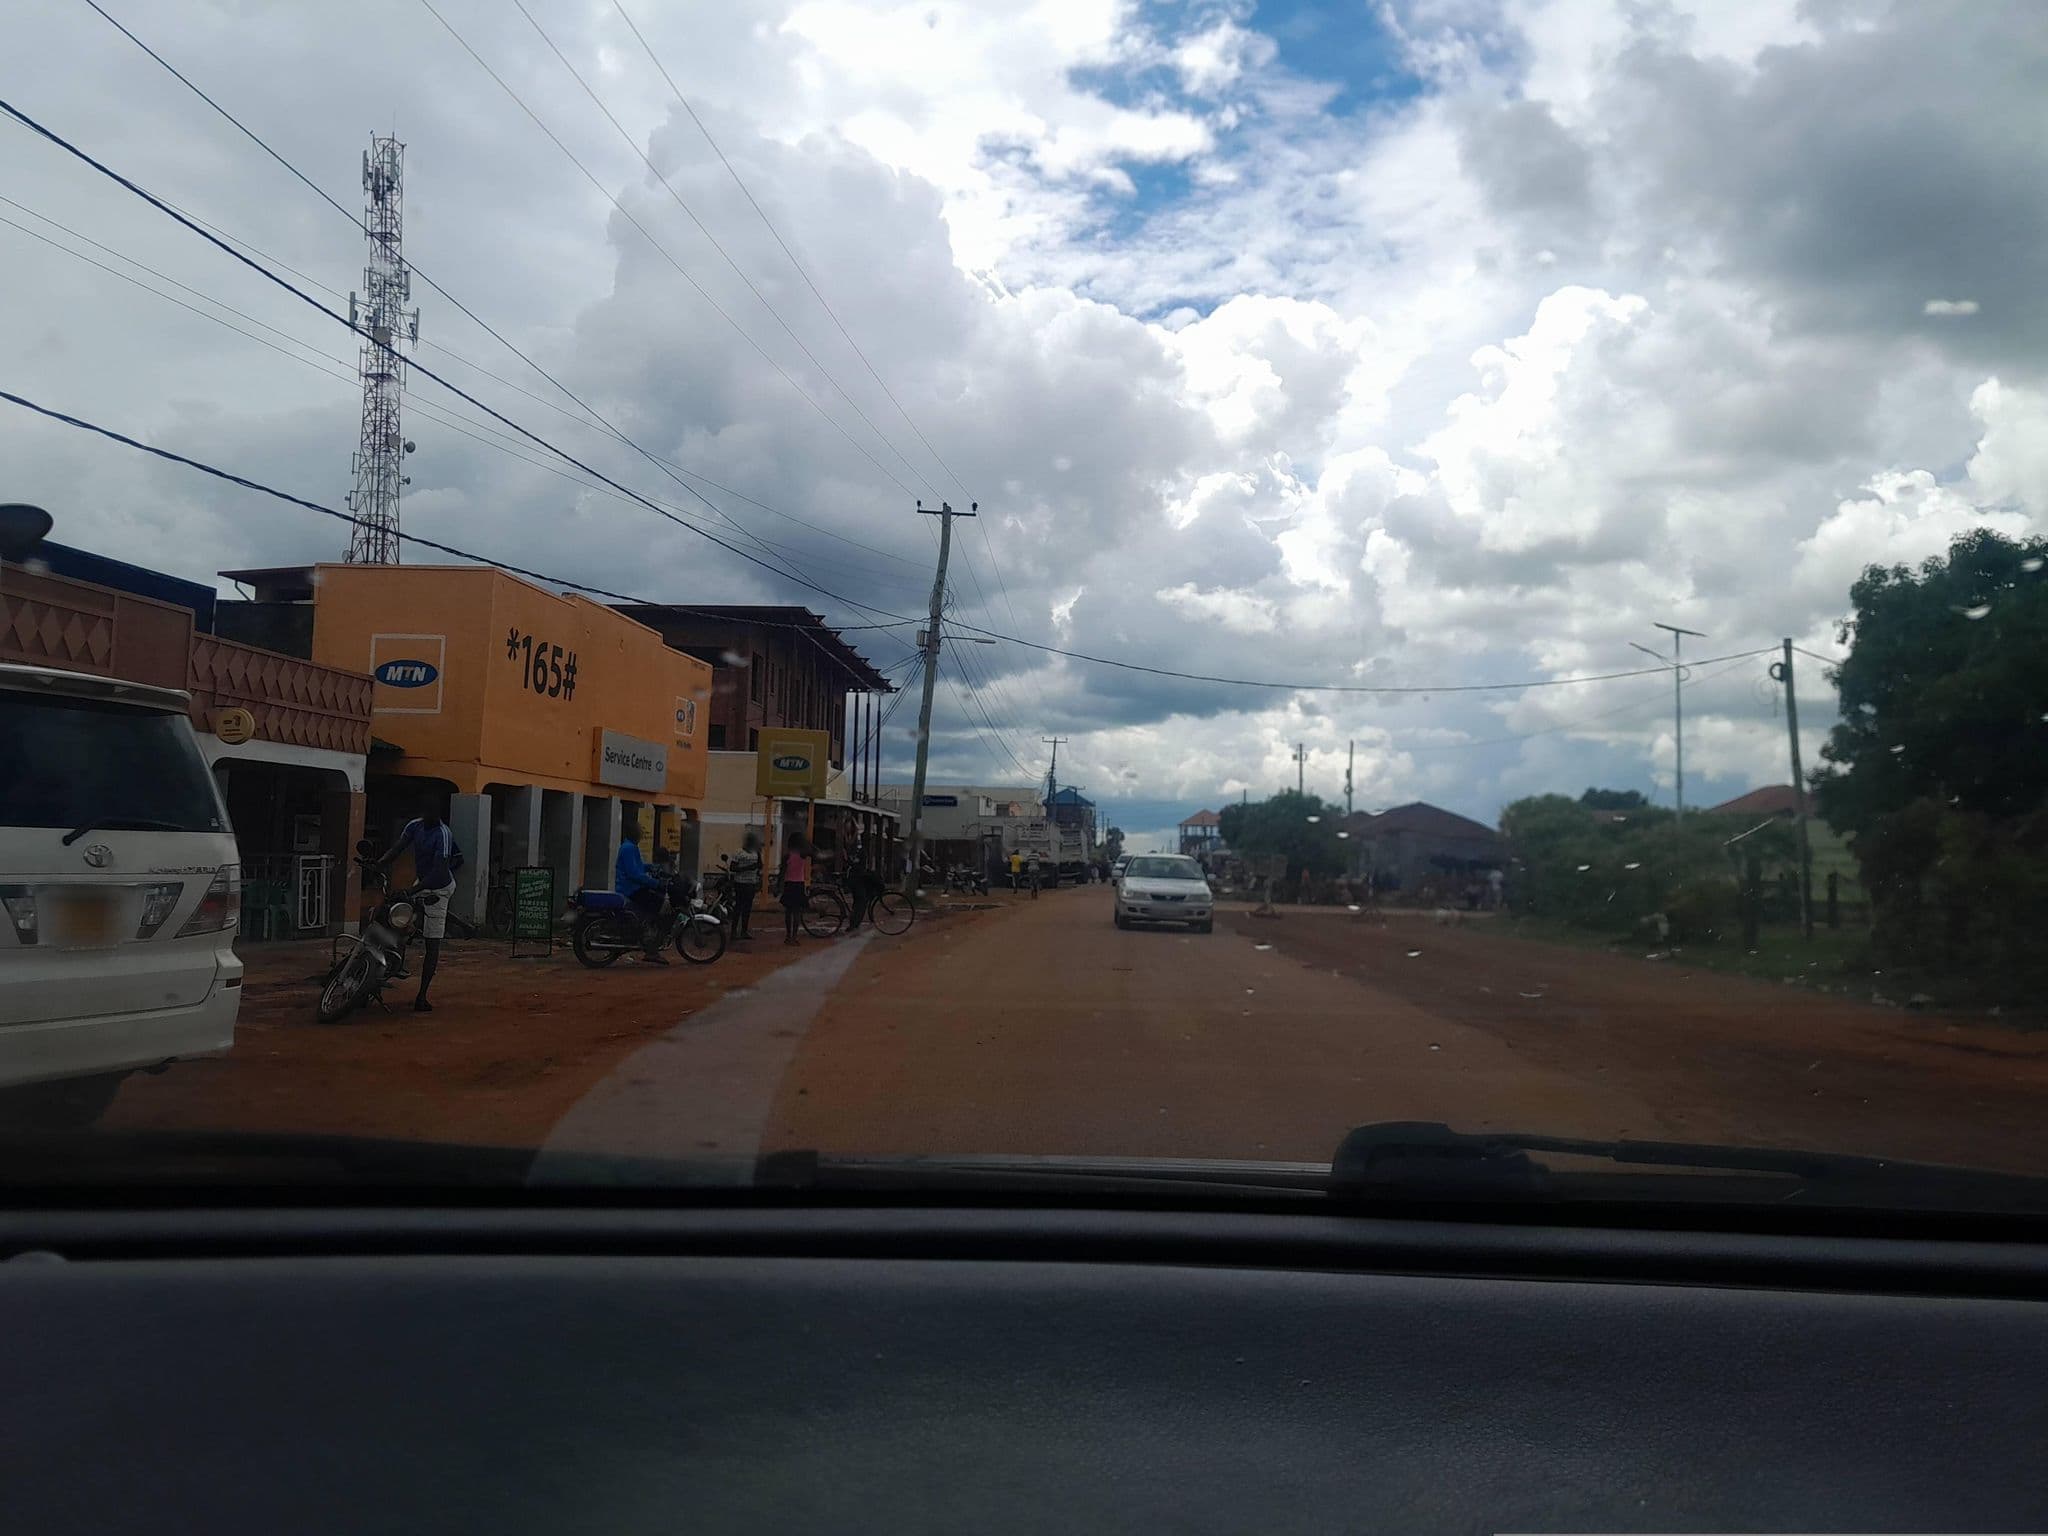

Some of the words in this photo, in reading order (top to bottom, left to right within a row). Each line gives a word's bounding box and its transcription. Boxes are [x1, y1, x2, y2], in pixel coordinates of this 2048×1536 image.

[386, 666, 426, 681] MTN
[605, 747, 630, 766] Service
[631, 753, 652, 771] Centre
[779, 758, 805, 768] MTN
